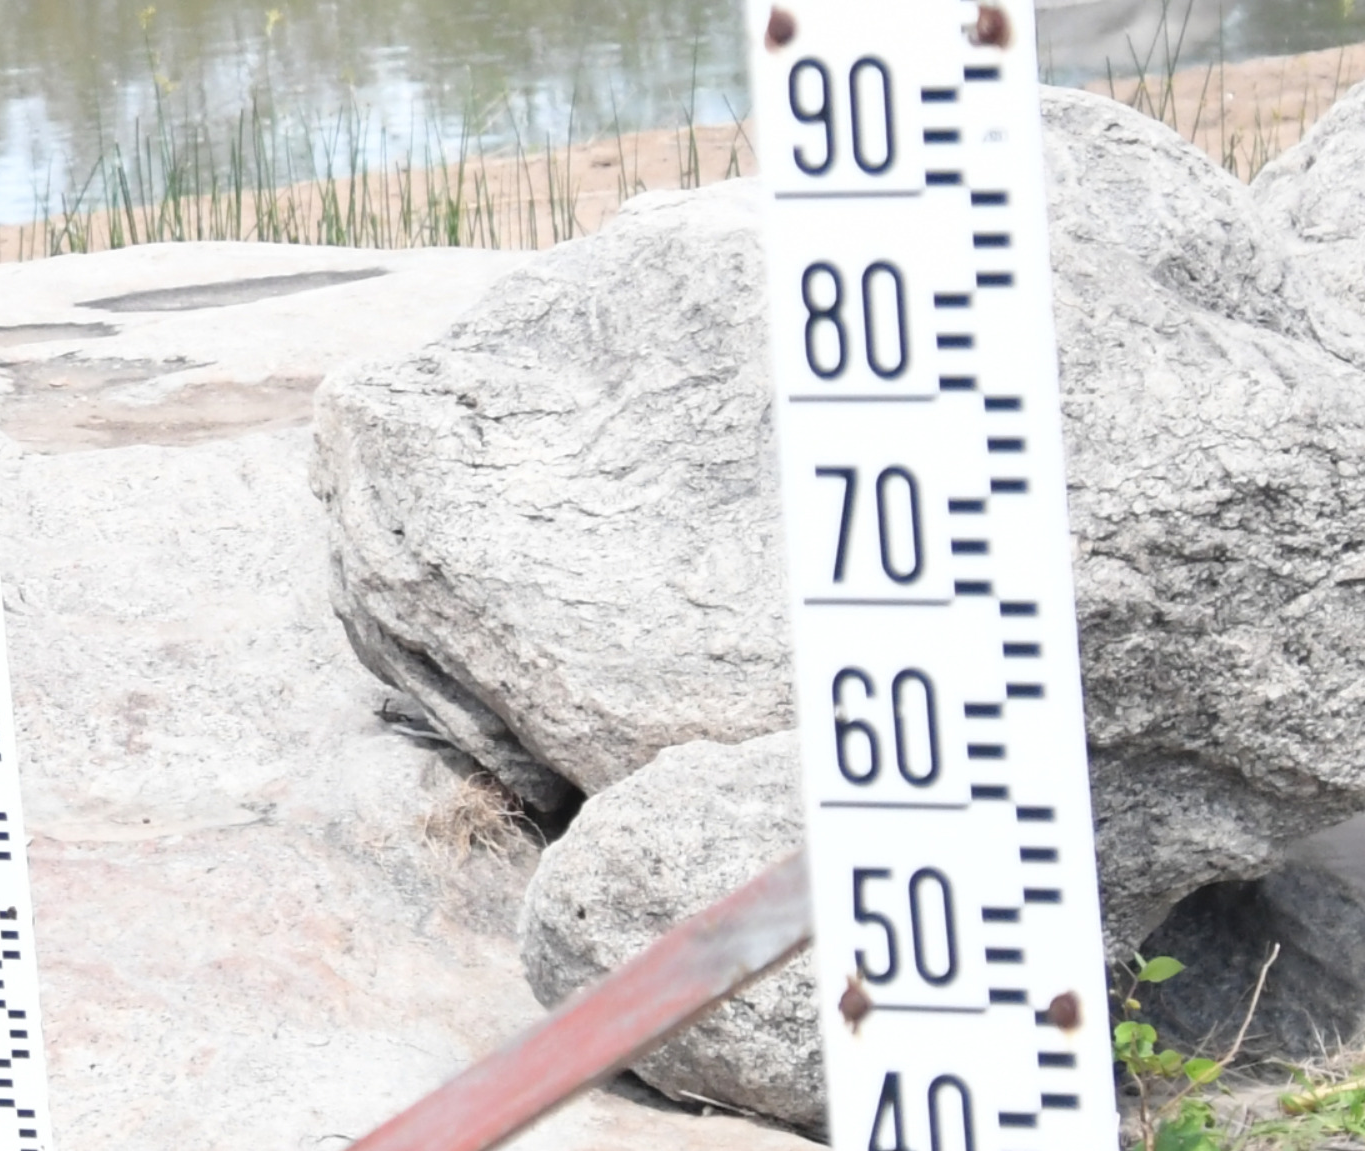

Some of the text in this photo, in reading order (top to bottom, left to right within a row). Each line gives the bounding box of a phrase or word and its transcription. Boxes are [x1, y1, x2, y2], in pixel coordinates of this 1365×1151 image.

[787, 55, 898, 178] 90
[800, 259, 911, 381] 80
[814, 464, 926, 586] 70
[830, 666, 942, 789] 60
[852, 866, 960, 986] 50
[866, 1071, 976, 1151] 40
